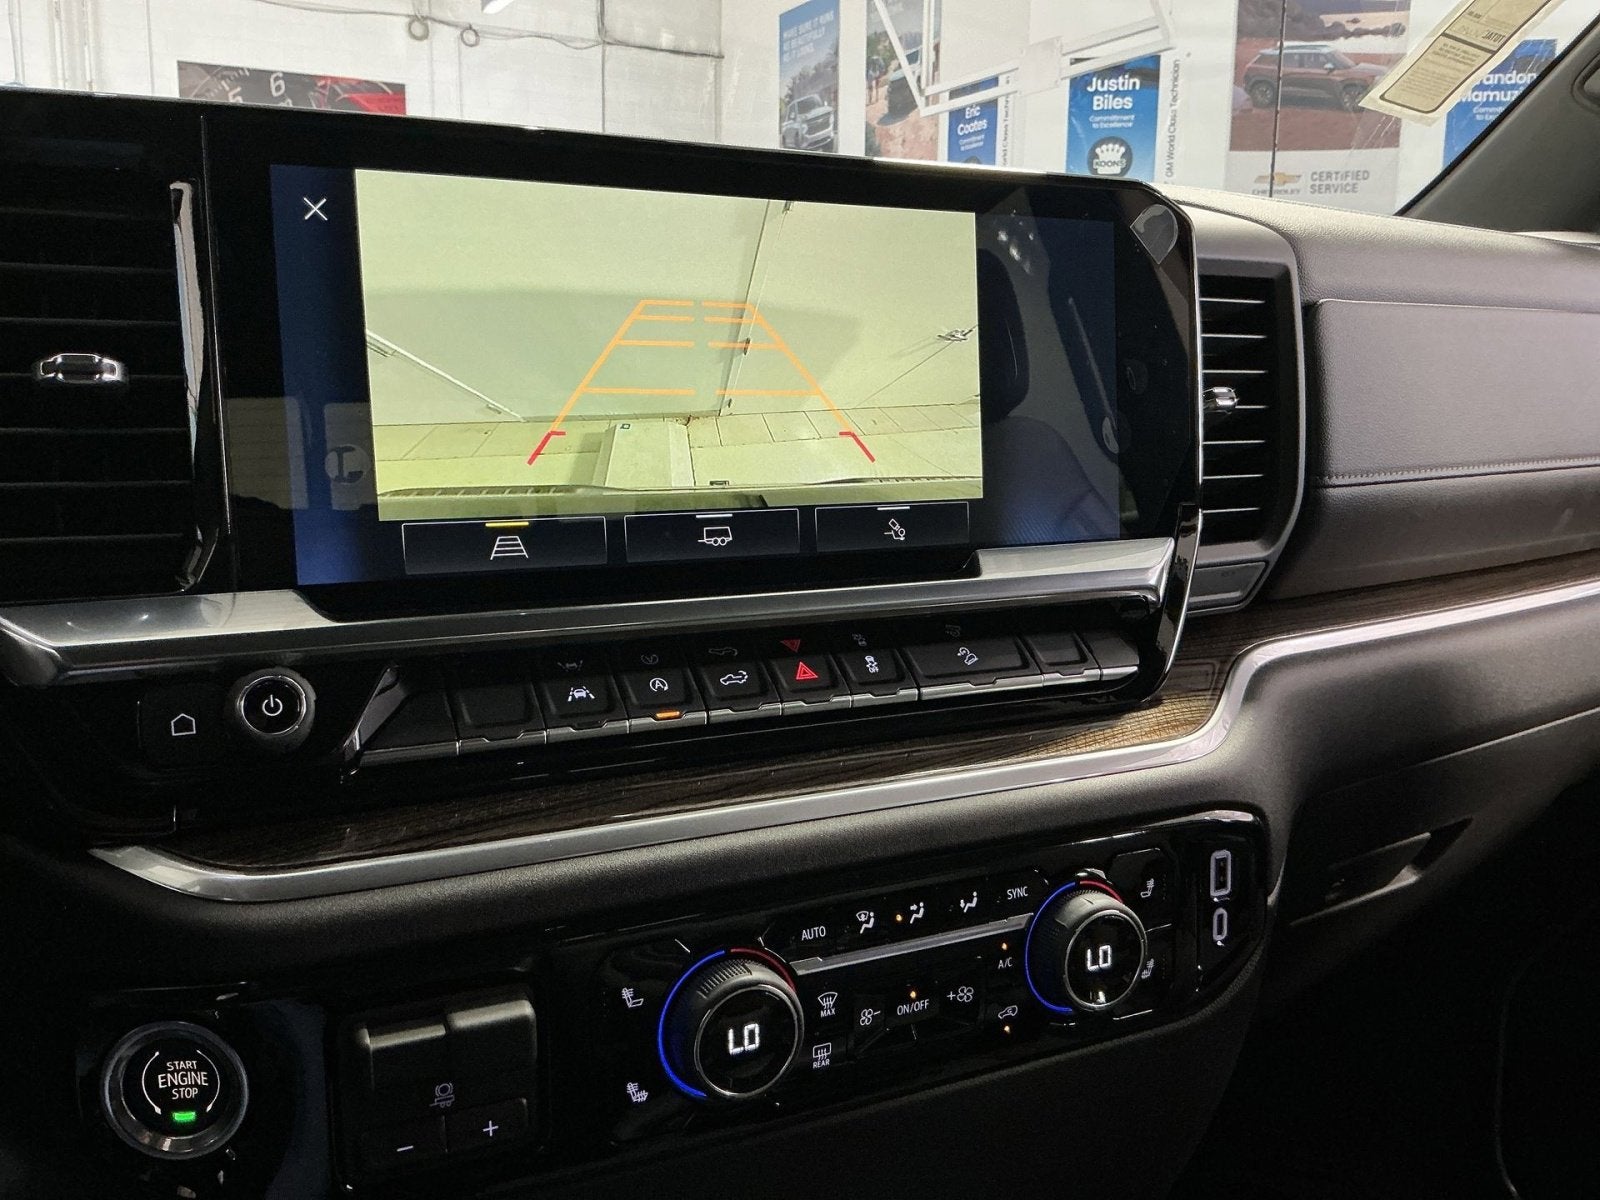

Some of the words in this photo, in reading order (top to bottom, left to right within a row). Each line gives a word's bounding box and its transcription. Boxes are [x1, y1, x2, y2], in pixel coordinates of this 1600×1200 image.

[270, 72, 286, 98] 6
[1086, 74, 1141, 92] Justin
[1170, 59, 1181, 108] Technician
[1481, 70, 1537, 85] andon
[1092, 94, 1134, 111] Biles
[965, 103, 981, 119] Eric
[957, 119, 988, 136] Coates
[1168, 109, 1177, 133] Class
[1166, 134, 1176, 161] World
[1310, 170, 1370, 182] CERTIFIED
[1309, 183, 1359, 195] SERVICE
[1006, 885, 1029, 900] SYNC
[801, 926, 826, 941] AUTO
[997, 956, 1014, 970] A/C
[1086, 944, 1112, 971] LO
[820, 1007, 836, 1018] MAX
[896, 998, 930, 1016] ON/OFF
[728, 1023, 760, 1056] LO
[166, 1060, 198, 1071] START
[812, 1058, 830, 1069] REAR
[157, 1071, 209, 1089] ENGINE
[171, 1087, 199, 1100] STOP
